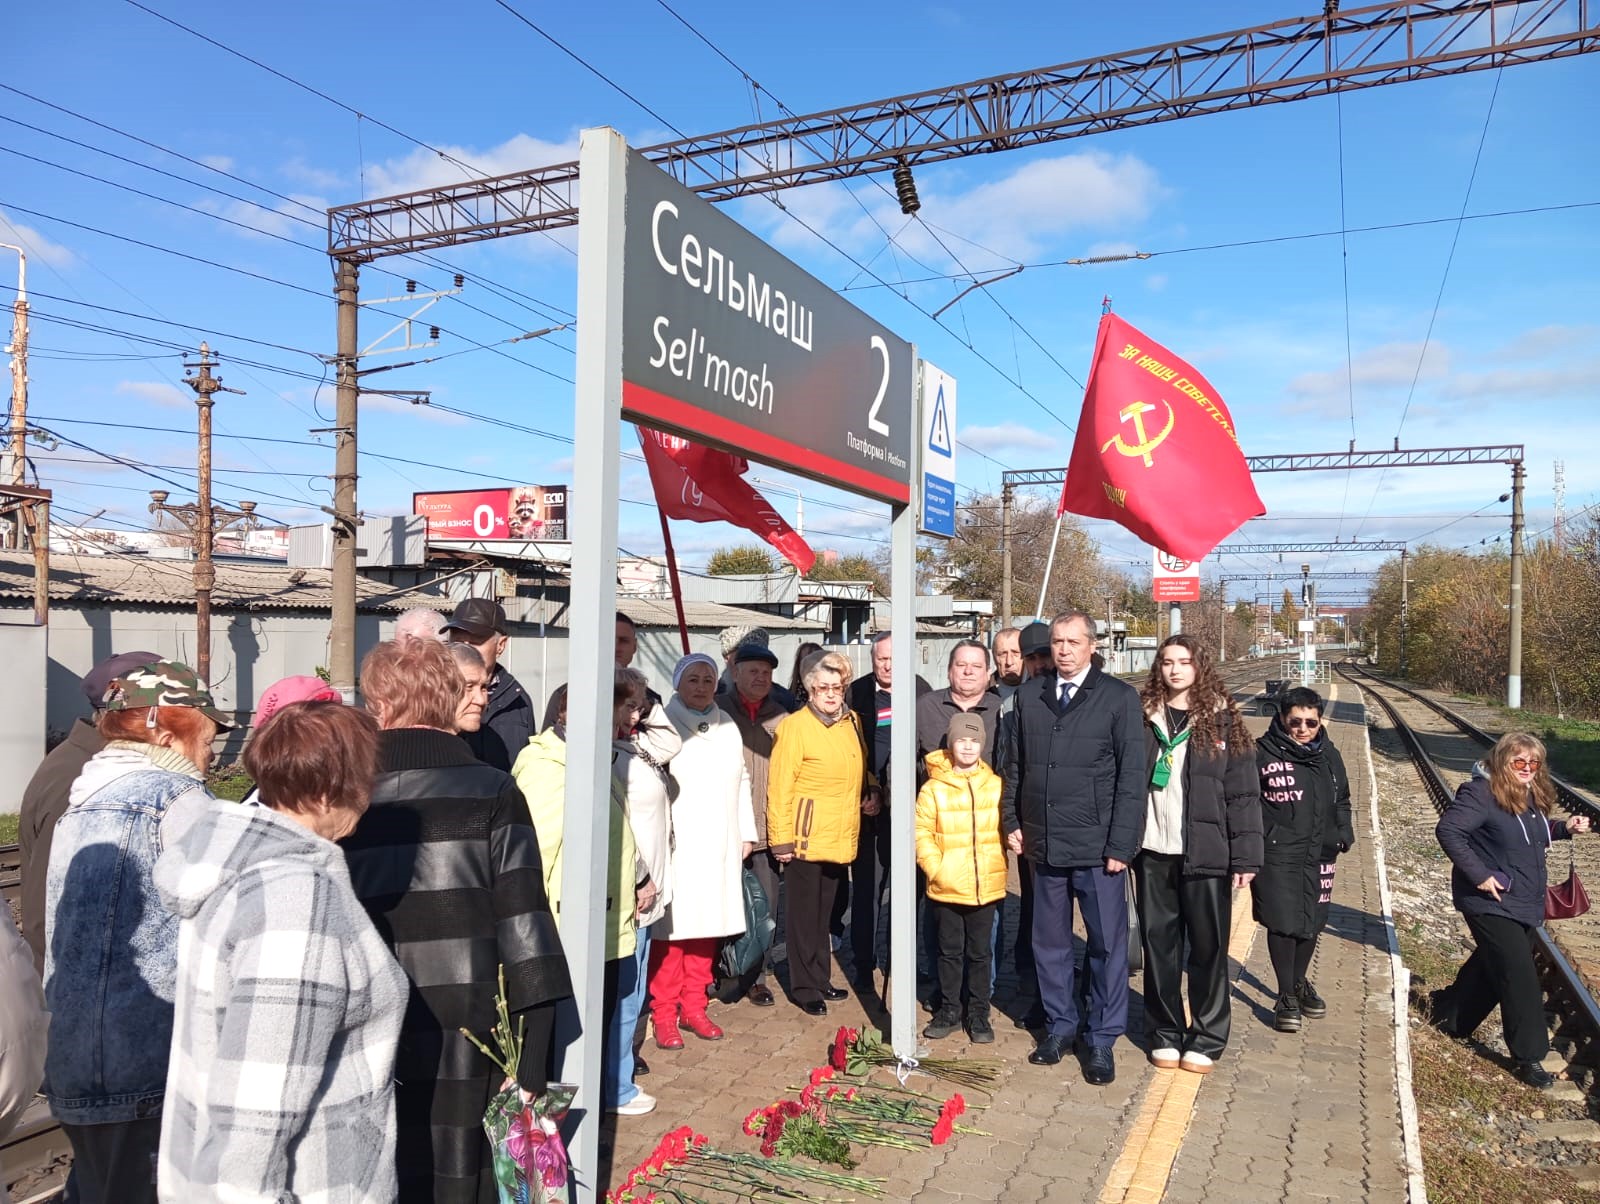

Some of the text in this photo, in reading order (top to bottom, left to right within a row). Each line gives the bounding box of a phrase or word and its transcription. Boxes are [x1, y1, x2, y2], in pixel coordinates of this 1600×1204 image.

[652, 200, 813, 352] Сельмаш
[649, 316, 774, 414] Sel'mash
[1118, 344, 1141, 360] ЗА
[1135, 355, 1178, 382] НАШУ
[868, 335, 890, 437] 2
[847, 431, 907, 470] Платформа Platform
[1261, 761, 1294, 775] LOVE
[1268, 776, 1295, 788] AND
